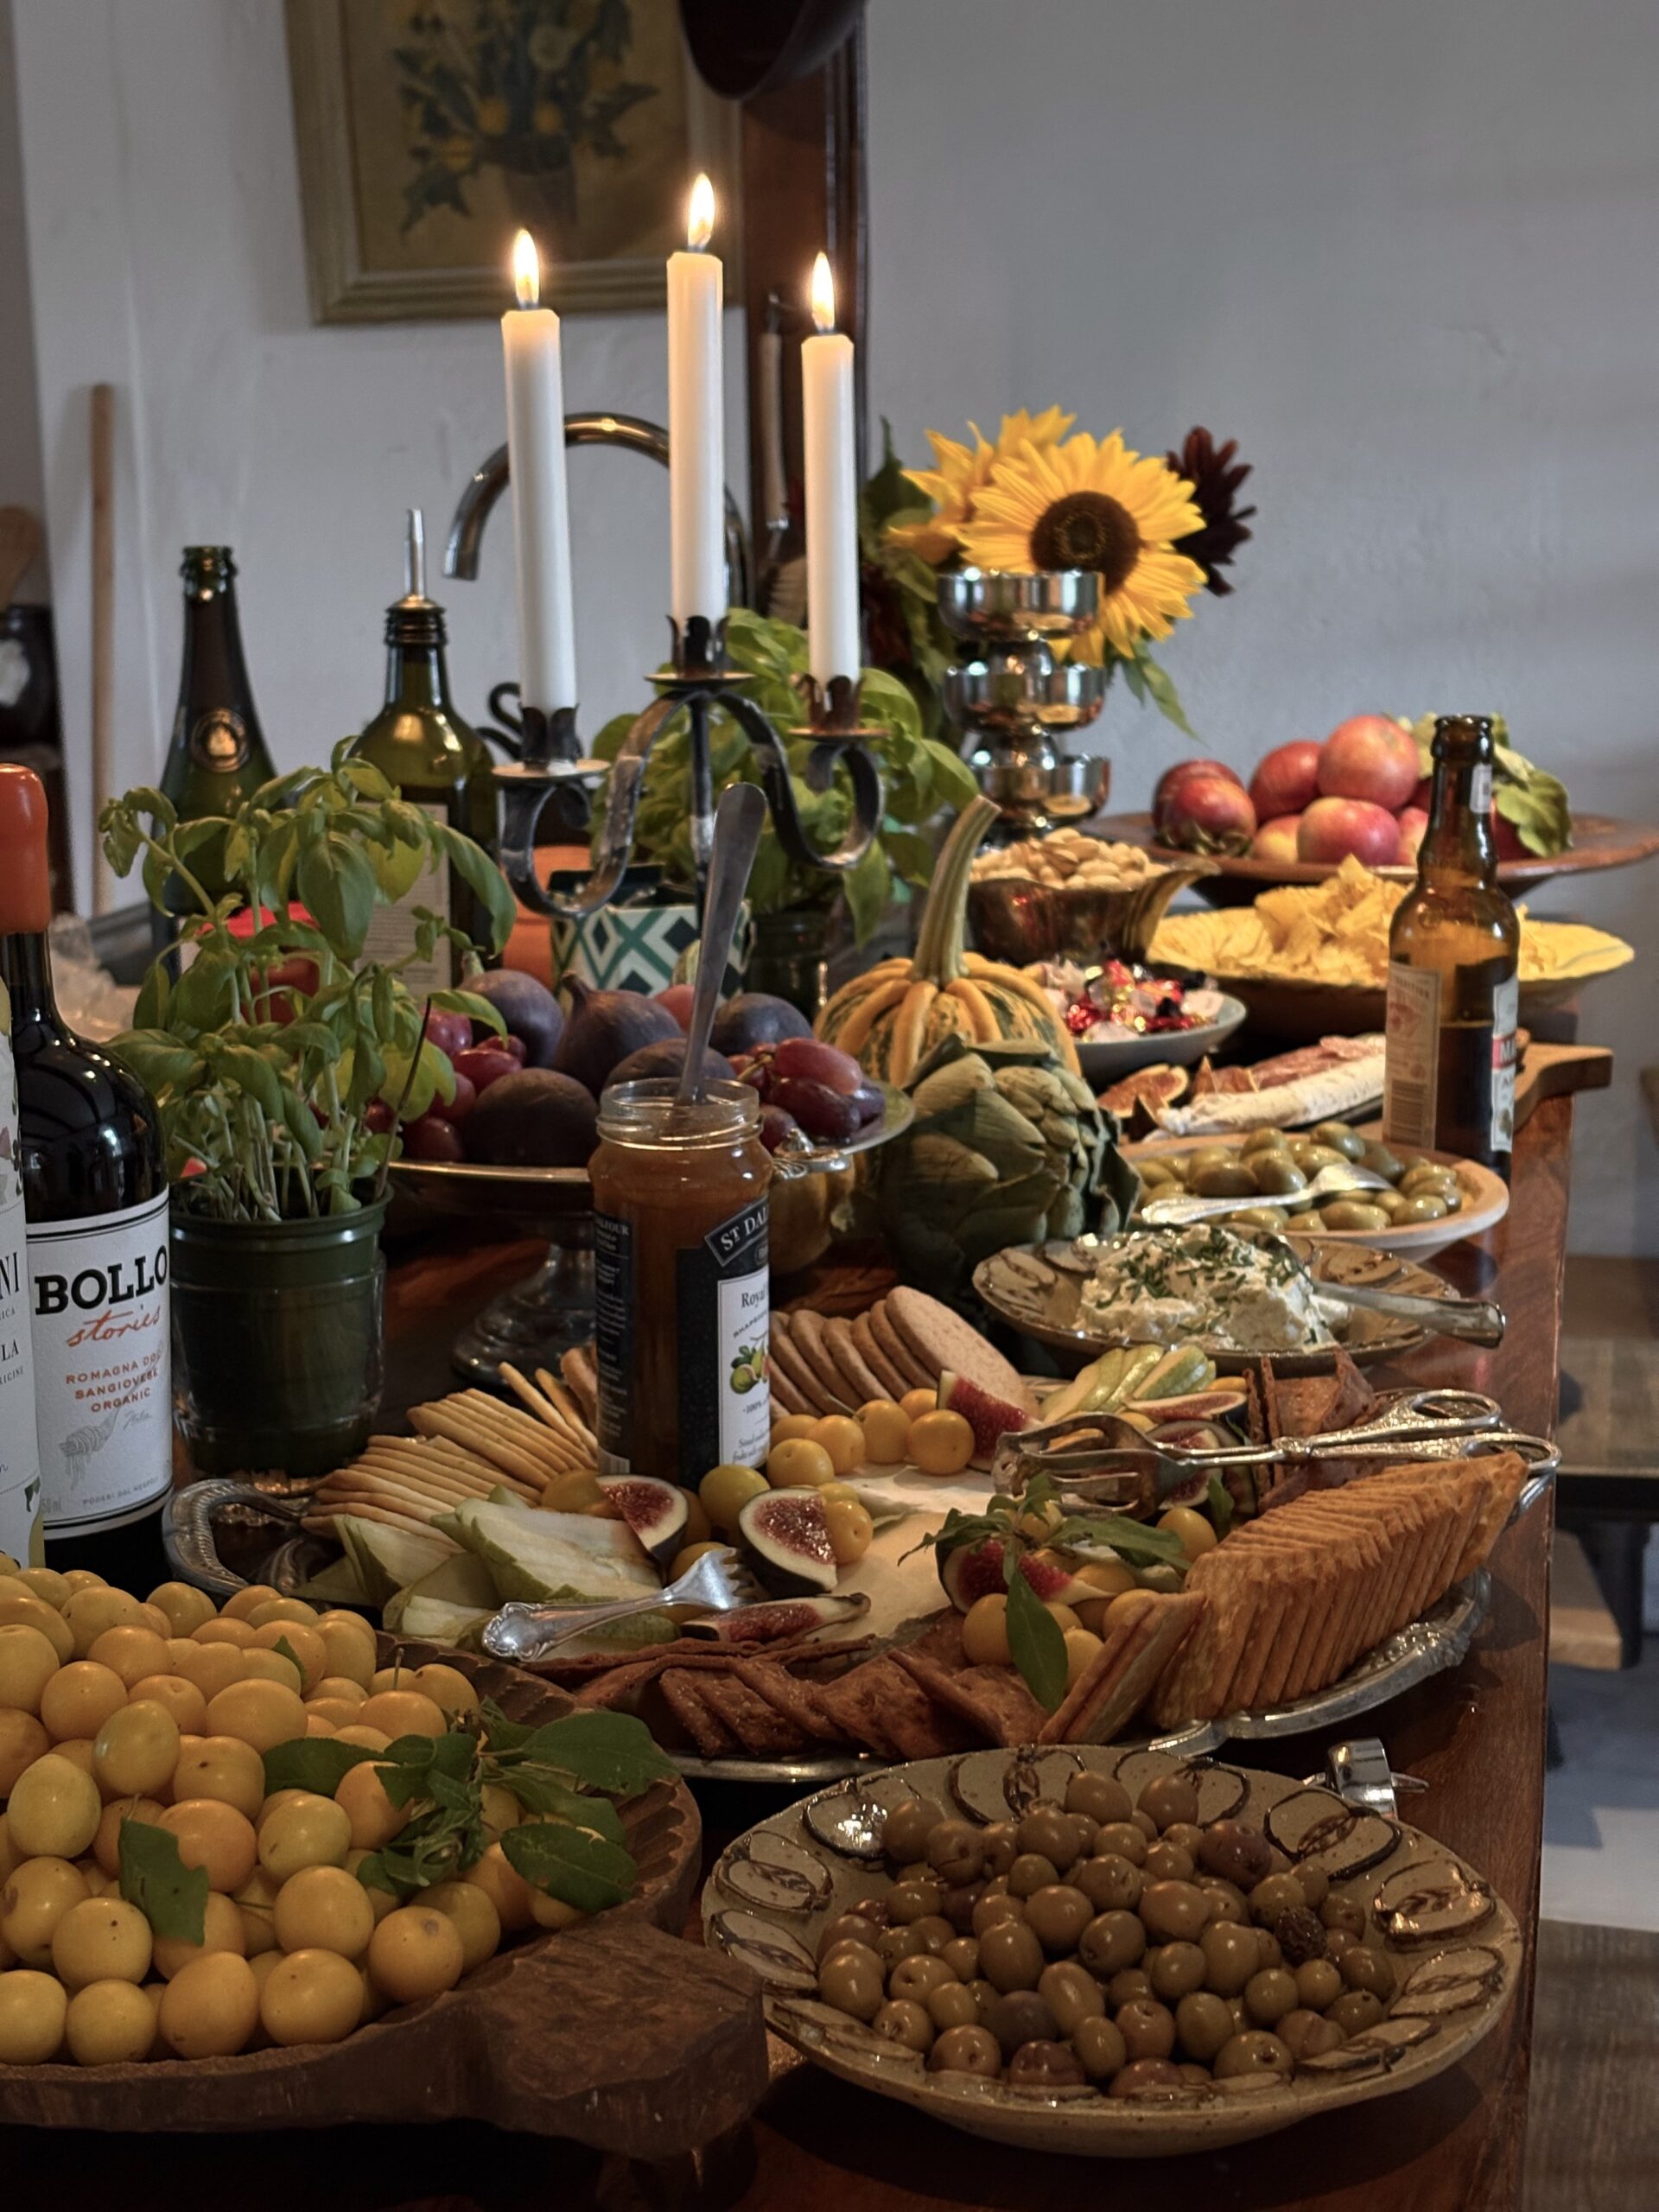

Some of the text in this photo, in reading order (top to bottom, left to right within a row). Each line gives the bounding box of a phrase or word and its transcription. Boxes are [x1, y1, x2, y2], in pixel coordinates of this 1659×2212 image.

[744, 1206, 768, 1236] DAL
[35, 1245, 168, 1315] BOLLO
[0, 1306, 16, 1321] ICA
[66, 1304, 161, 1347] stories
[66, 1360, 138, 1384] ROMAGNA
[74, 1368, 158, 1400] SANGIOVESE
[91, 1387, 151, 1413] ORGANIC
